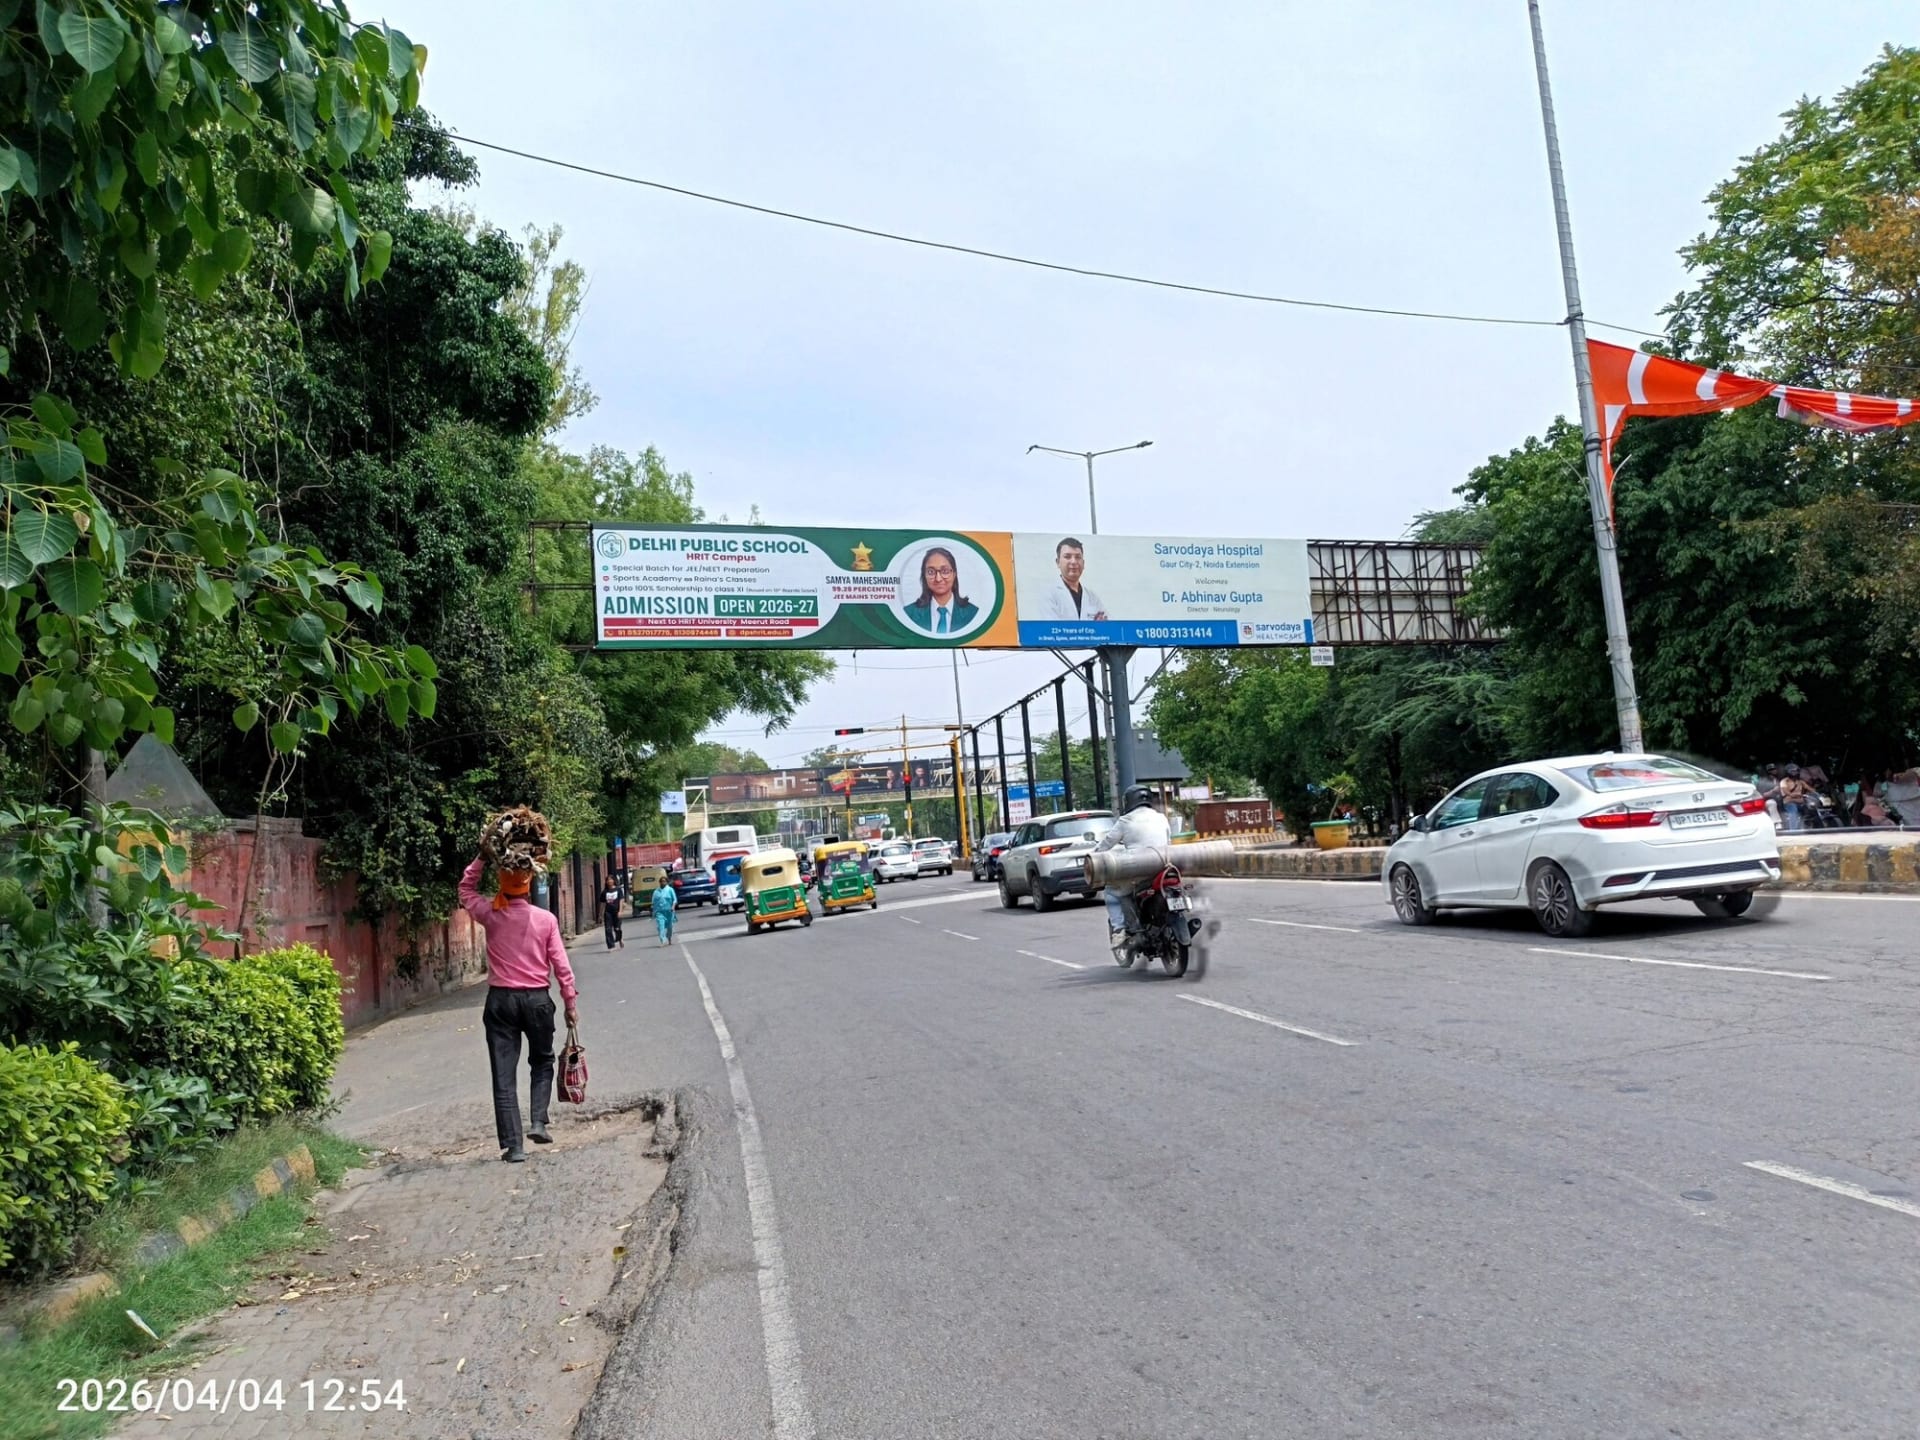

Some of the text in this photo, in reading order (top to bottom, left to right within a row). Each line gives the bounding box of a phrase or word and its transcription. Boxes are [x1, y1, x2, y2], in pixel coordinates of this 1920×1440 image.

[629, 538, 809, 554] DELHI PUBLIC SCHOOL
[1154, 543, 1263, 558] Sarvodaya Hospital
[686, 552, 757, 563] HRIT Campus
[612, 564, 643, 572] Special
[645, 564, 670, 572] Batch
[724, 566, 770, 574] Preparation
[1226, 561, 1260, 569] Extension
[613, 574, 641, 582] Sports
[642, 575, 682, 583] Academy
[825, 576, 901, 585] SAMYA MAHESHWARI
[656, 585, 703, 593] Scholarship
[1162, 591, 1263, 605] Dr. Abhinav Gupta
[603, 596, 709, 615] ADMISSION
[720, 599, 814, 613] OPEN 2026-27
[697, 618, 737, 626] University
[1255, 623, 1301, 632] sarvodaya
[1256, 632, 1303, 640] HEALTHCARE
